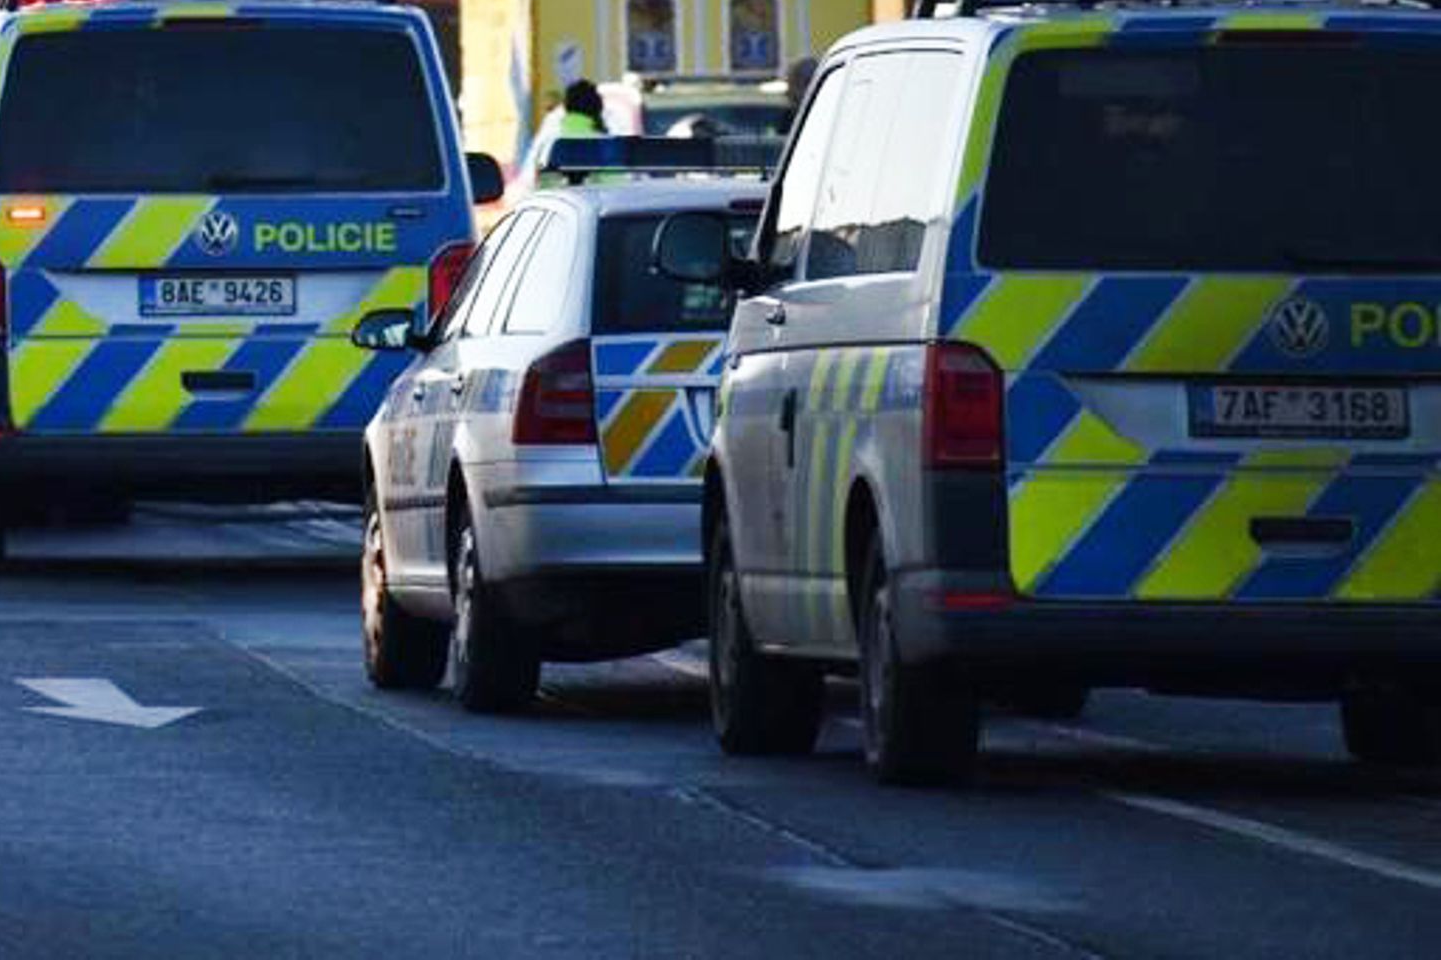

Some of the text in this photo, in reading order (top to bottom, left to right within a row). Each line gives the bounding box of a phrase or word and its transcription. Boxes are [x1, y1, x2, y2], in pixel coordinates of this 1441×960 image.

[254, 222, 397, 252] POLICIE
[161, 280, 283, 304] 8AE 9426
[1351, 301, 1441, 348] PO
[1308, 390, 1390, 422] 3168
